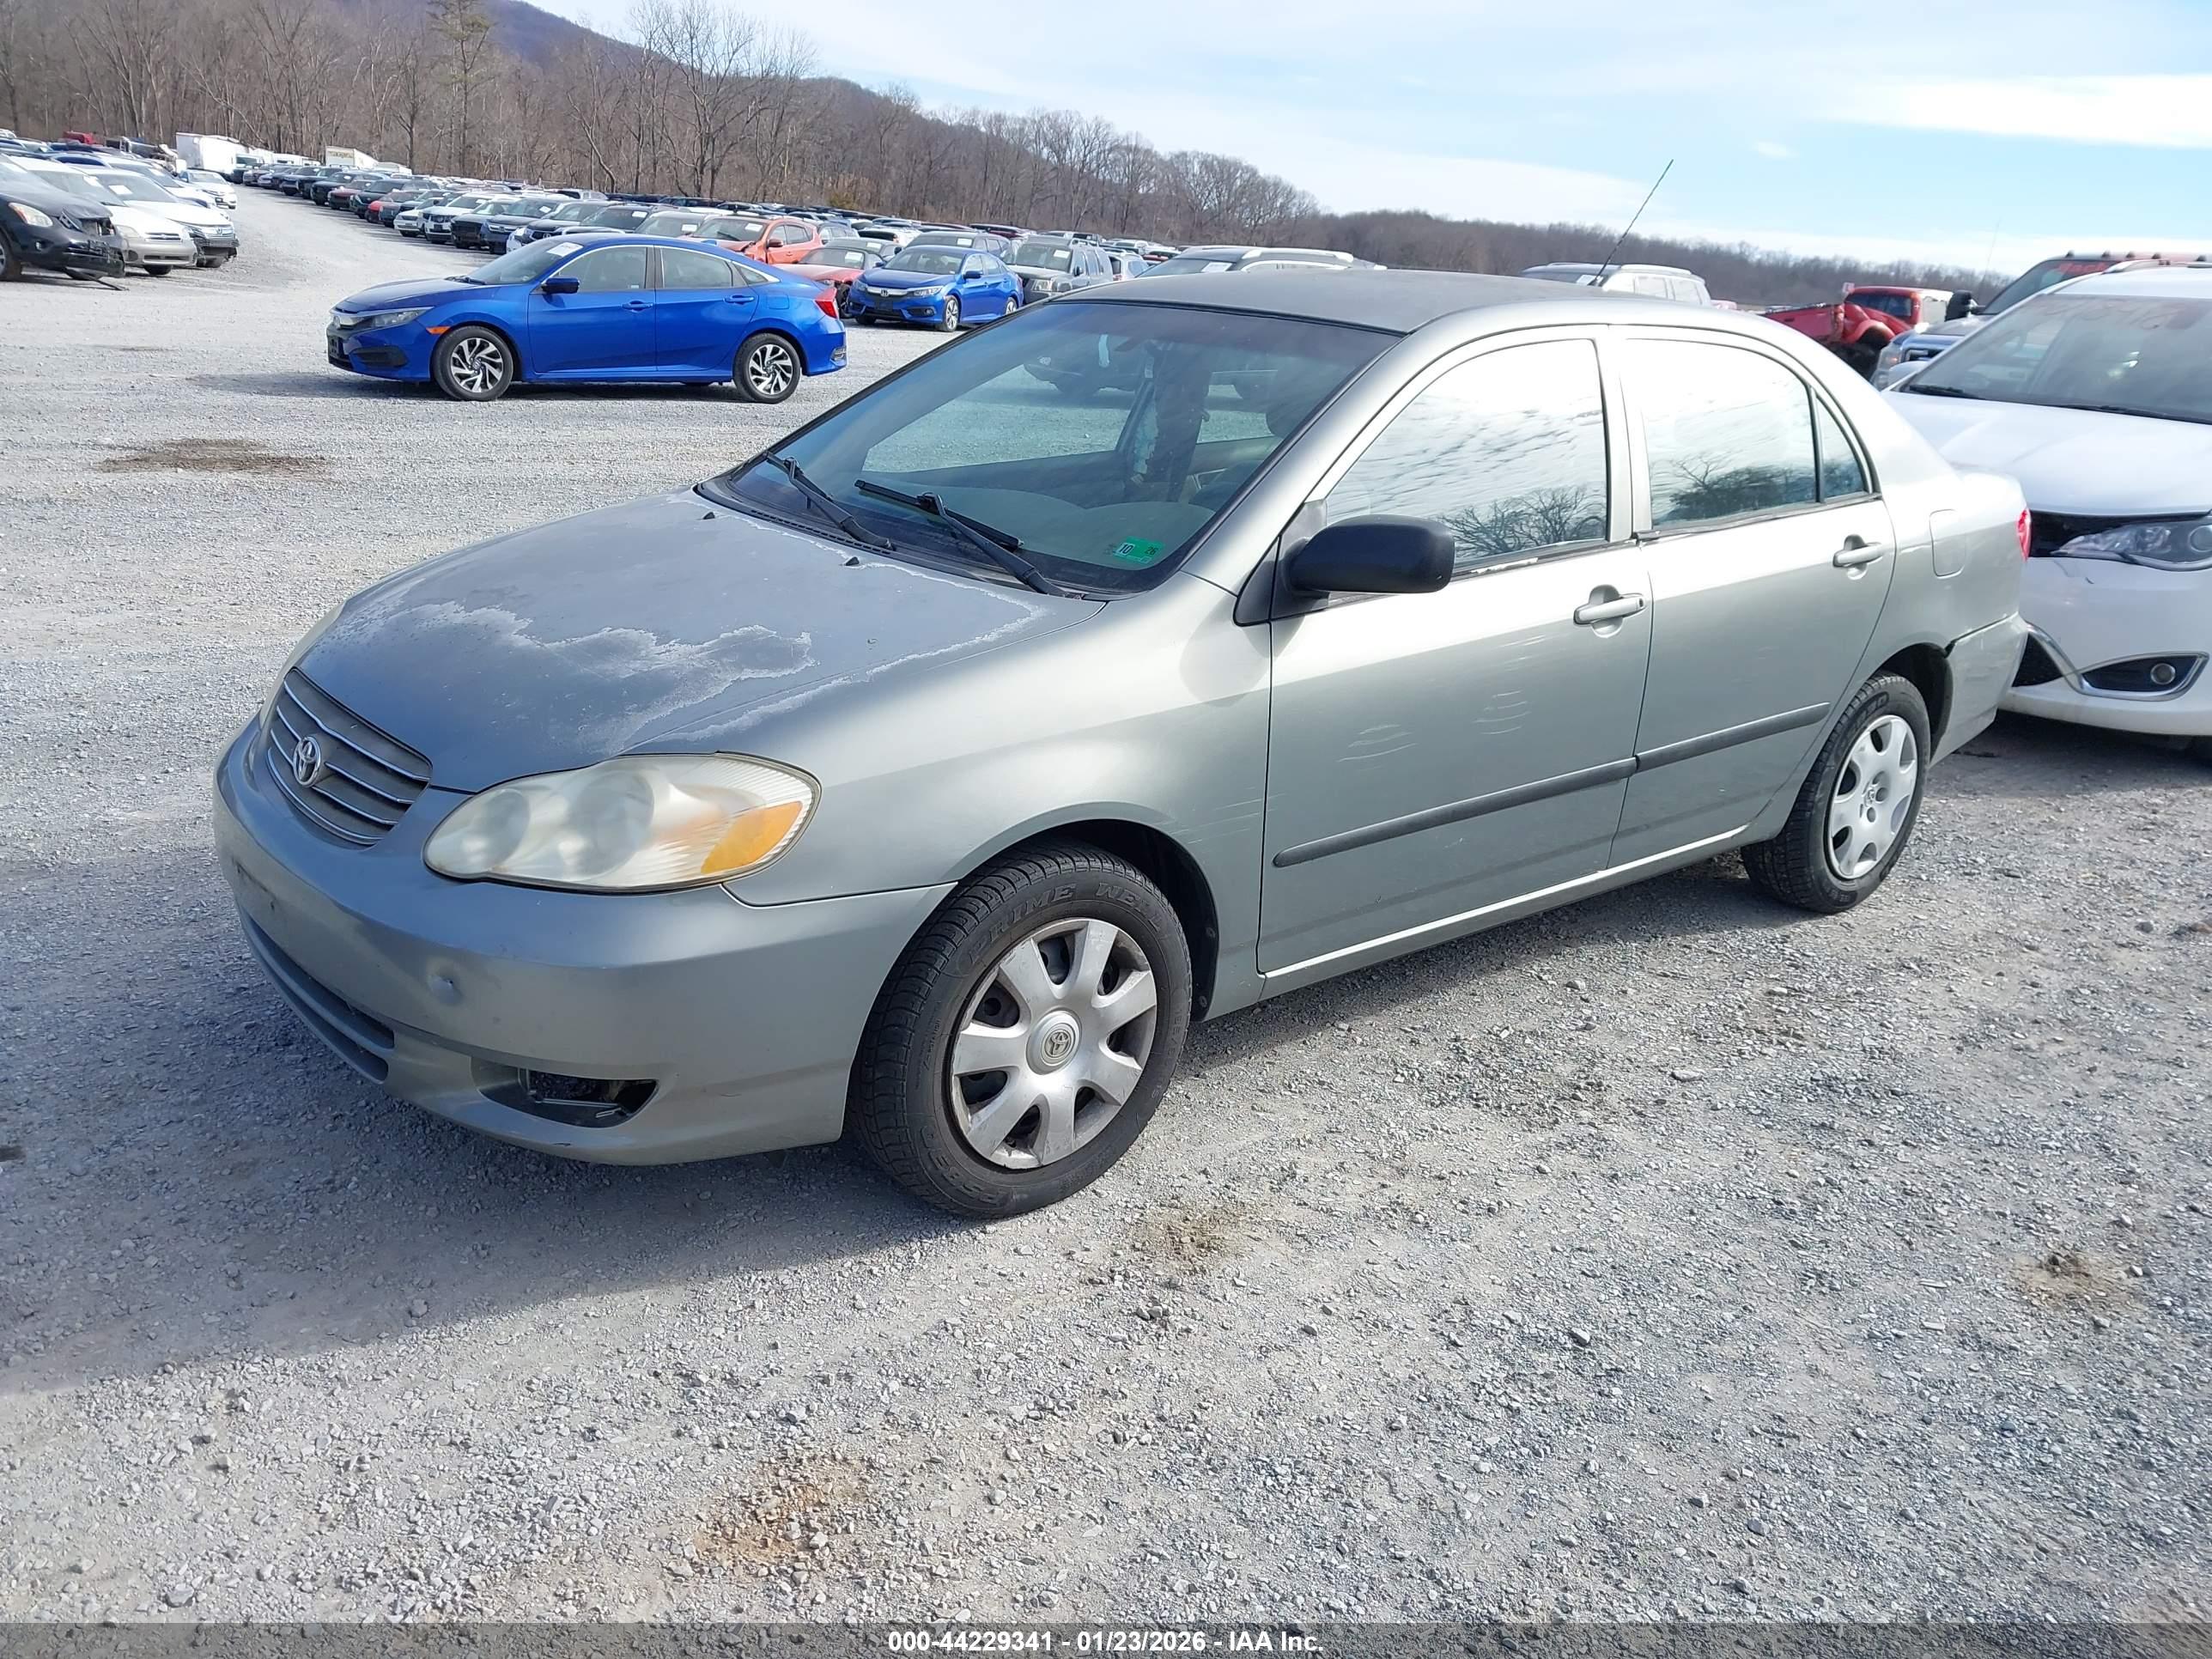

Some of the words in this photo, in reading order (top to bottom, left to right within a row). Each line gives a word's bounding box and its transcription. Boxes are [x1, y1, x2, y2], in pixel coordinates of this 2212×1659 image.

[1119, 544, 1134, 555] 10
[969, 883, 1077, 966] PRIME
[1094, 881, 1164, 933] WELL
